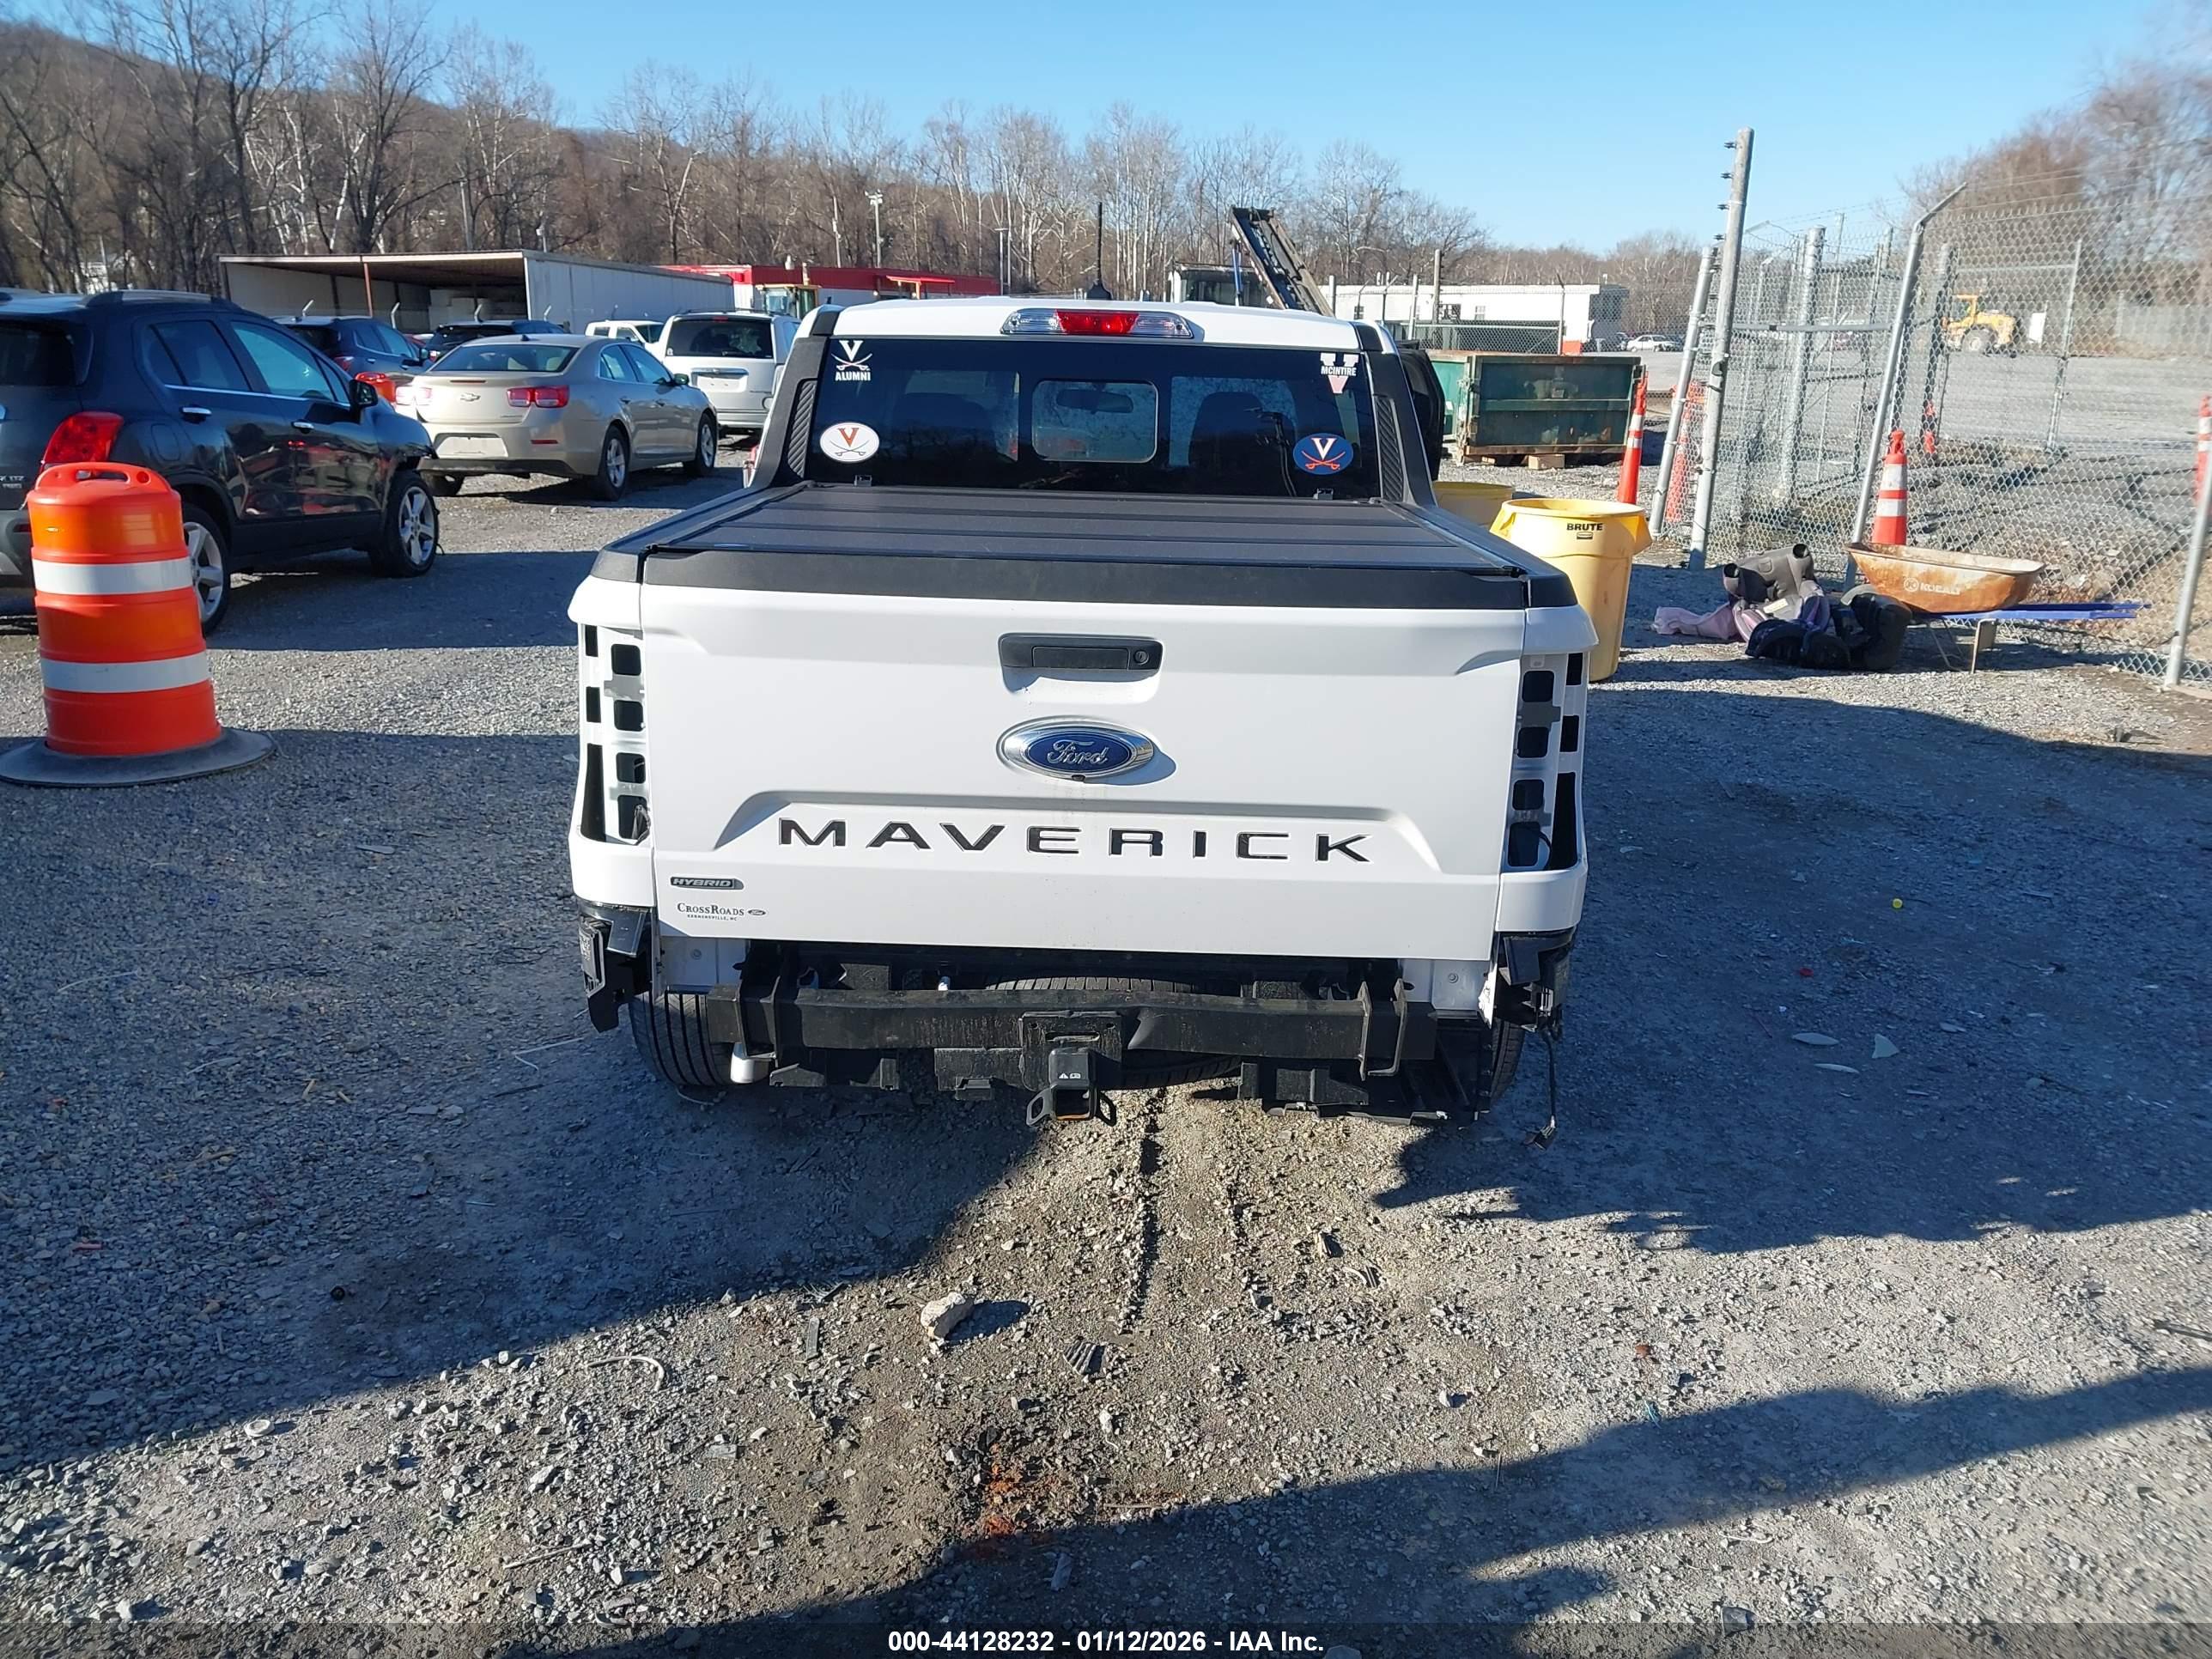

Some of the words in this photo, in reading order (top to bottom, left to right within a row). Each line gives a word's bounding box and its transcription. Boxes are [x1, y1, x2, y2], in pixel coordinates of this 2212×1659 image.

[836, 371, 871, 381] ALUMNI
[1321, 366, 1357, 376] MCINTIRE
[838, 428, 860, 447] V
[1311, 437, 1337, 460] V
[1566, 522, 1603, 531] BRUTE
[1047, 739, 1110, 765] Ford
[779, 817, 1372, 863] MAVERICK
[673, 878, 732, 887] HYBRID
